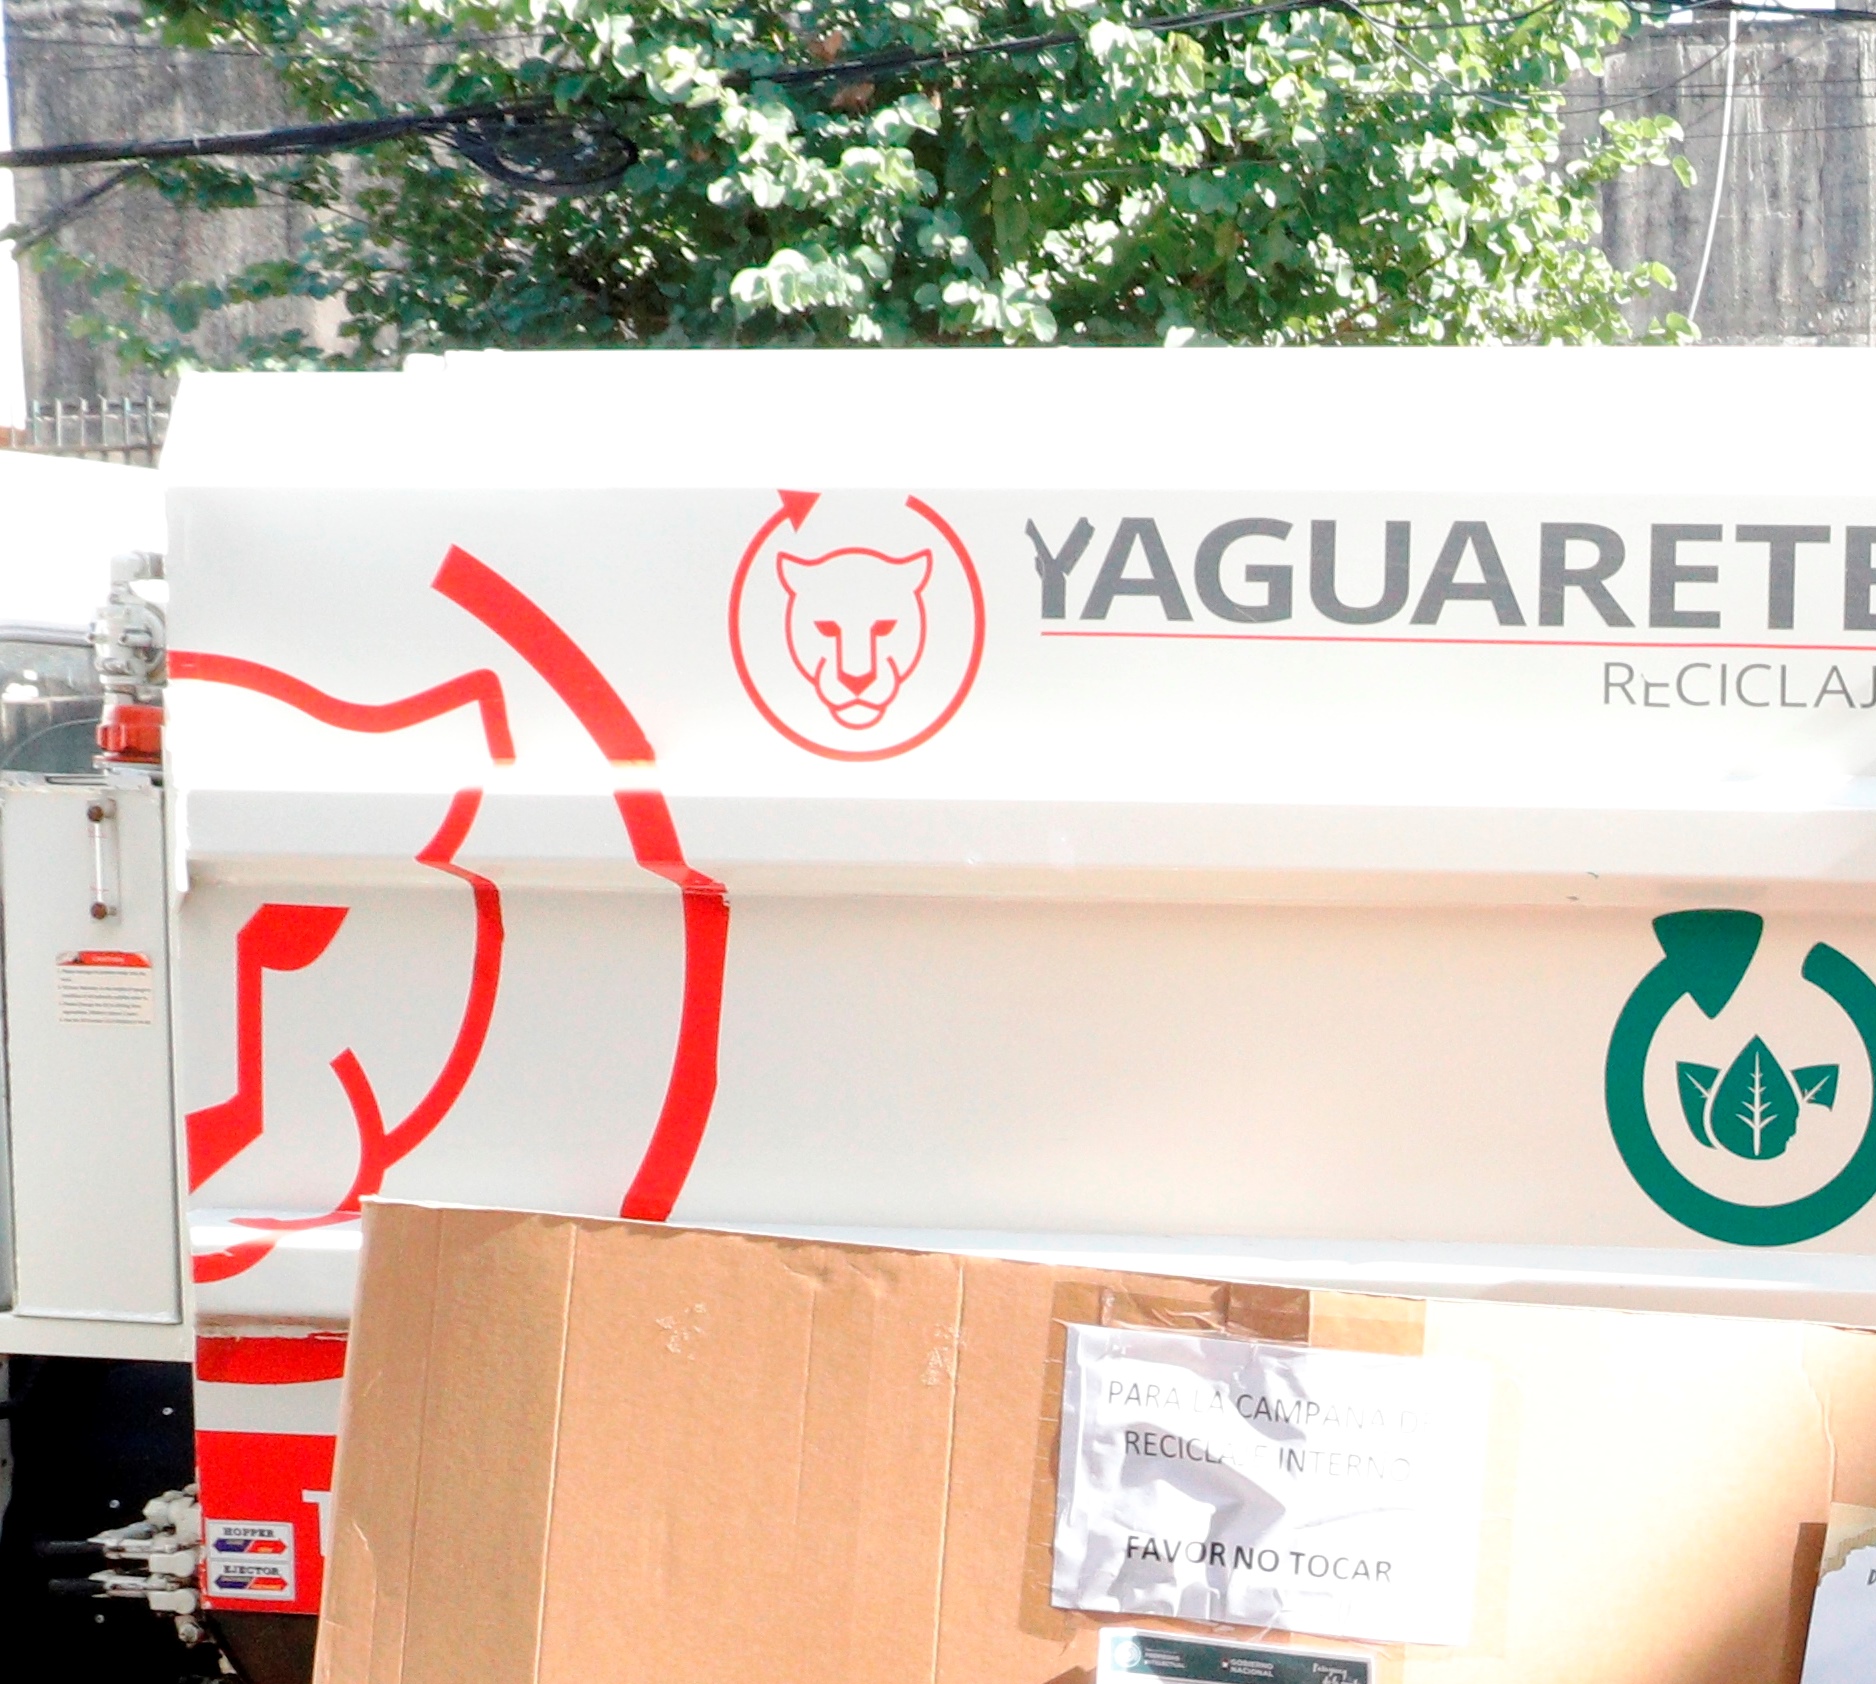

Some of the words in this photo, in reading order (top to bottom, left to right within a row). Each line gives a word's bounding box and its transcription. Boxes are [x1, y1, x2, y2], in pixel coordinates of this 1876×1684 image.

[1108, 1380, 1180, 1410] PARA
[1193, 1385, 1226, 1414] LA
[1278, 1447, 1412, 1482] INTERNO
[223, 1527, 274, 1538] HOPPER
[224, 1565, 280, 1575] EJECTOR
[1126, 1535, 1227, 1567] FAVOR
[1233, 1545, 1280, 1573] NO
[1289, 1551, 1393, 1583] TOCAR
